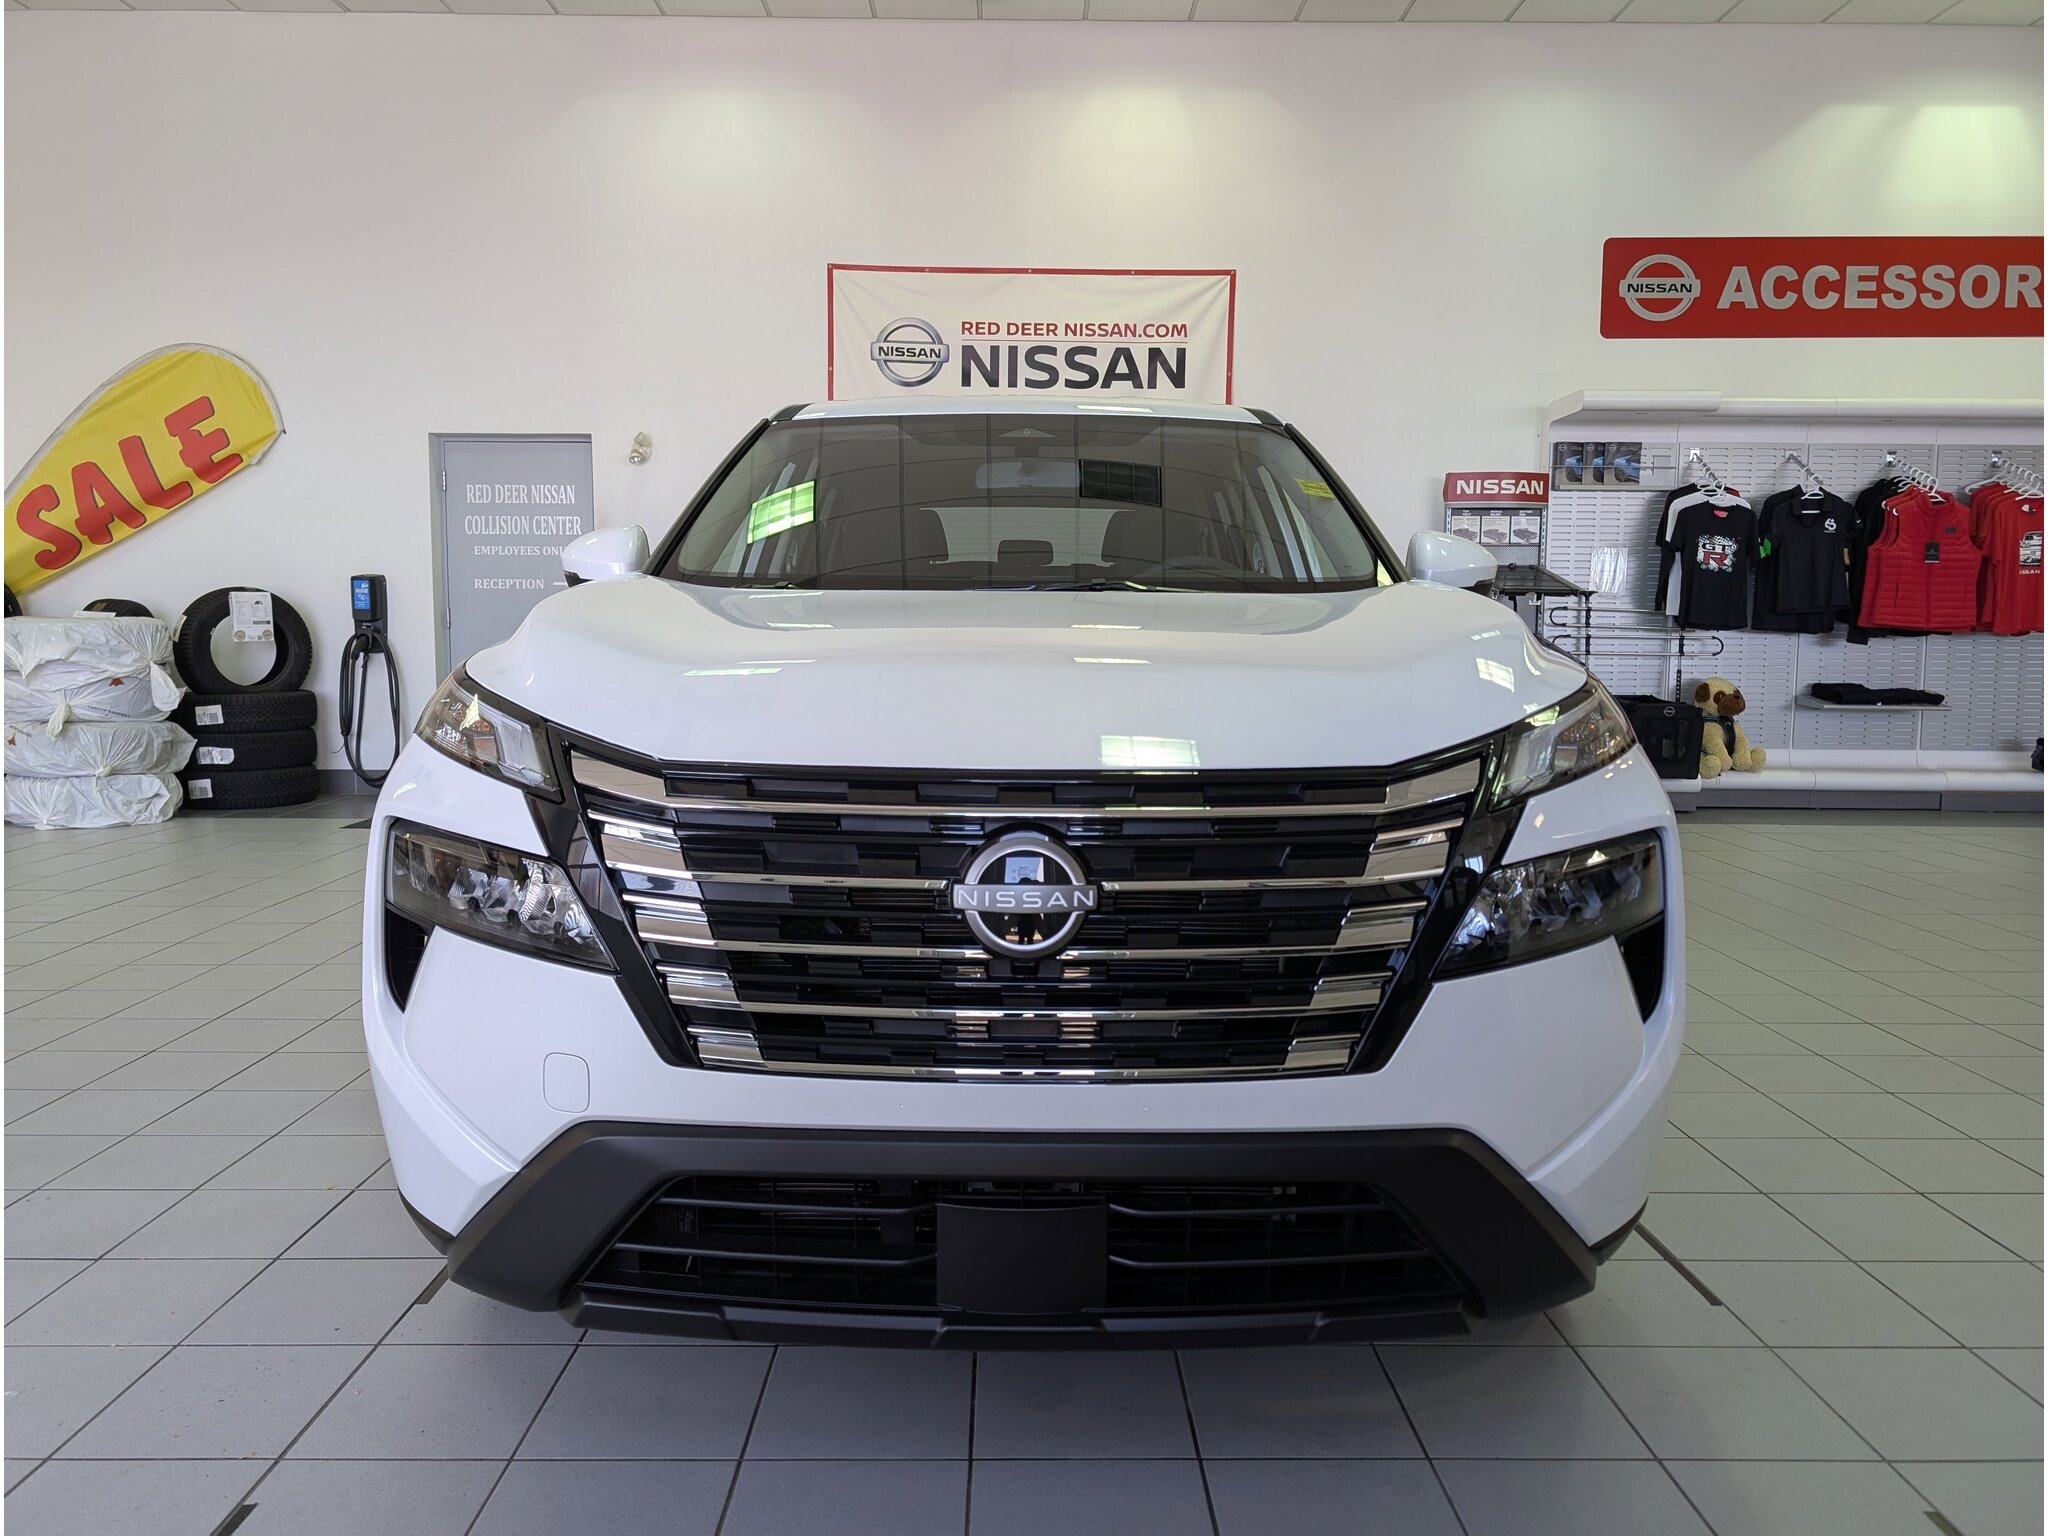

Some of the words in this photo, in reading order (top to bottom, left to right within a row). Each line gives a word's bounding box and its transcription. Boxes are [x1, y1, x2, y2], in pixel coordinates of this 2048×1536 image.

[1626, 282, 1693, 294] NISSAN
[1716, 264, 2043, 310] ACCESSOR
[960, 321, 1000, 336] RED
[1006, 322, 1058, 337] DEER
[1064, 323, 1188, 338] NISSAN.COM
[878, 346, 941, 359] NISSAN
[961, 345, 1187, 390] NISSAN
[16, 396, 243, 570] SALE
[1456, 479, 1544, 496] NISSAN
[466, 484, 492, 504] RED
[495, 484, 528, 504] DEER
[531, 484, 575, 504] NISSAN
[464, 515, 530, 535] COLLISION
[533, 516, 582, 535] CENTER
[474, 545, 540, 556] EMPLOYEES
[474, 578, 545, 590] RECEPTION
[957, 890, 1094, 908] NISSAN
